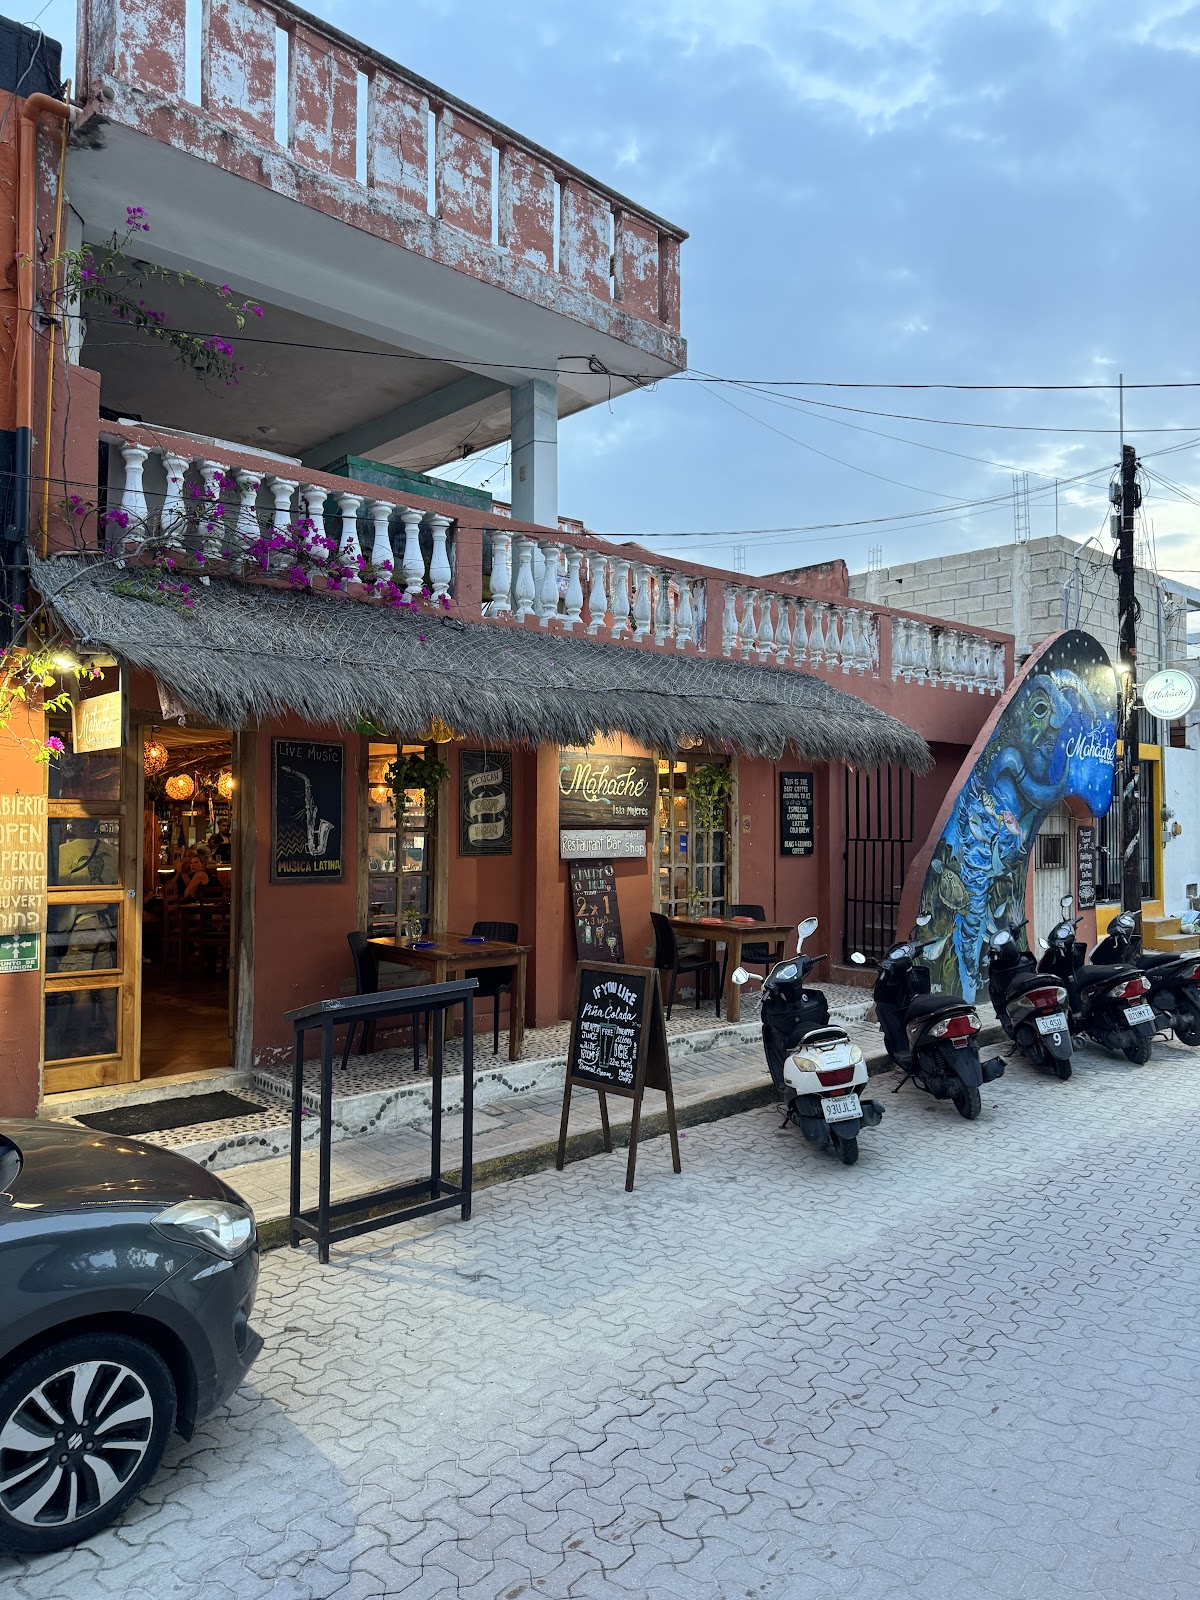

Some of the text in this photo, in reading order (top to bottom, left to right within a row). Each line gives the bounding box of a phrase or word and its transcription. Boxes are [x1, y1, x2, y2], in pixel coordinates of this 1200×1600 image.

[1066, 732, 1117, 760] Mahaché
[470, 772, 500, 787] MEXICAN
[559, 763, 649, 805] Mahaché
[0, 795, 48, 816] BIERTO
[612, 804, 625, 815] Isla
[561, 835, 622, 853] Restaurant Bar
[624, 841, 645, 856] Shop
[1, 850, 45, 872] PERTO
[278, 859, 341, 873] MUSICA LATINA
[0, 875, 47, 891] EÖFFNET
[0, 895, 44, 909] UVERT
[576, 896, 589, 917] 2
[602, 895, 610, 915] 1
[592, 981, 638, 1006] IF YOU LIKE
[581, 1002, 637, 1022] Piña Colada
[581, 1031, 598, 1040] JUICE
[1053, 1033, 1062, 1046] 9
[826, 1100, 857, 1116] 93UJL3
